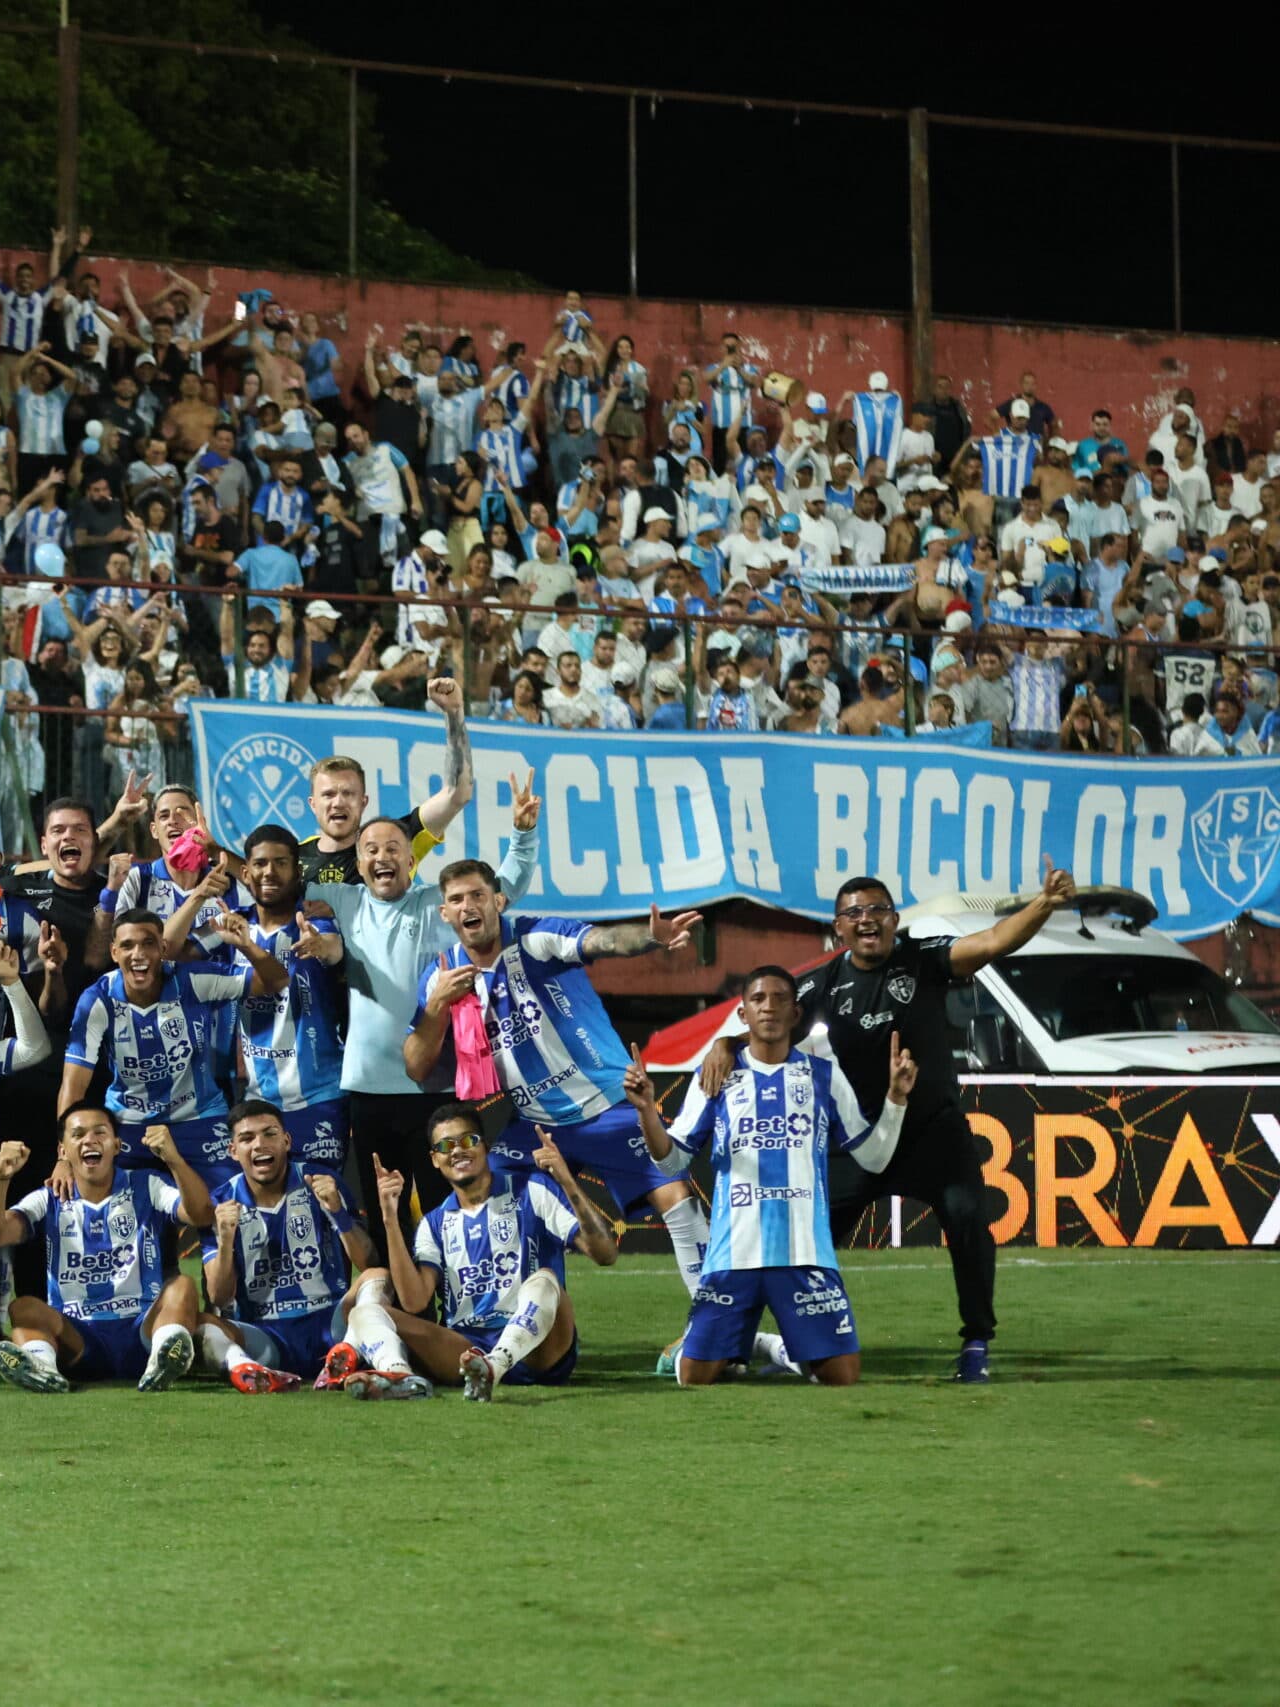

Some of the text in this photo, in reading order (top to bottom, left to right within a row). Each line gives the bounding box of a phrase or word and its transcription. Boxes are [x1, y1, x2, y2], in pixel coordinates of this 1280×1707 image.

[1173, 660, 1206, 686] 52
[814, 762, 1191, 916] BICOLOR
[738, 1116, 785, 1135] Bet
[750, 1136, 803, 1150] Sorte
[942, 1111, 1280, 1247] BRA
[67, 1251, 111, 1269] Bet
[255, 1253, 295, 1277] Bet
[79, 1268, 127, 1284] Sorte
[270, 1271, 313, 1289] Sorte
[463, 1277, 512, 1296] Sorte
